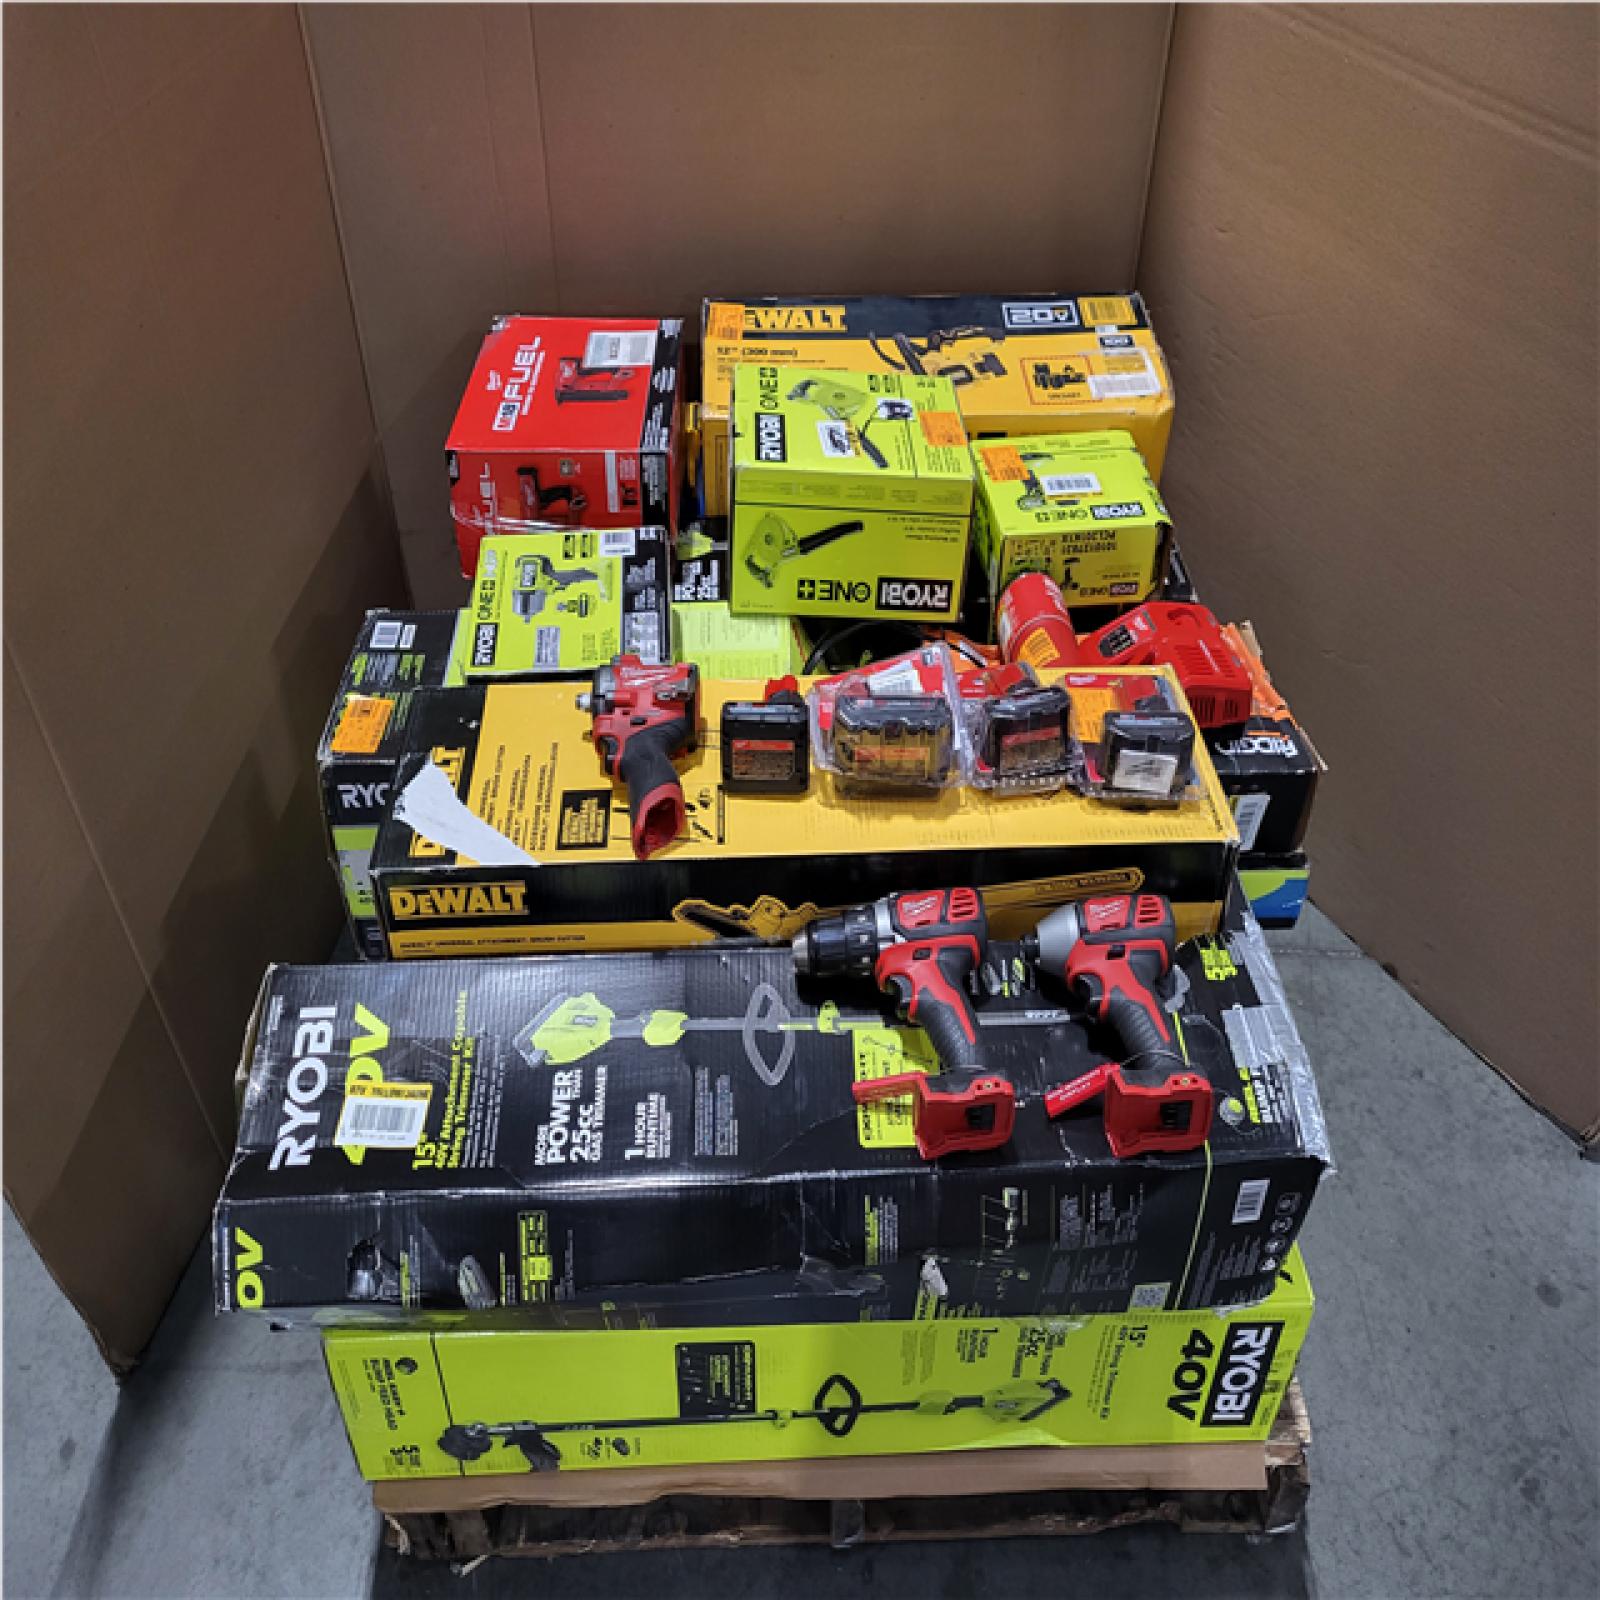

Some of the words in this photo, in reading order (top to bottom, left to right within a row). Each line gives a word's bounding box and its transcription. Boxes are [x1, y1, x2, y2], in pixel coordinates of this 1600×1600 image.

[744, 307, 848, 331] EWALT
[503, 335, 541, 401] FUEL
[759, 415, 781, 461] RYOBI
[797, 579, 871, 604] ONE+
[881, 582, 949, 609] RYOBI
[475, 624, 496, 666] RYOBI
[390, 885, 530, 916] DEWALT
[267, 1006, 338, 1171] RYOBI
[440, 1055, 461, 1141] Attachment
[454, 1061, 472, 1124] Trimmer
[547, 1070, 572, 1164] POWER
[594, 1065, 609, 1128] TRIMMER
[570, 1104, 595, 1164] 25cc
[634, 1102, 649, 1146] HOUR
[624, 1148, 645, 1161] 1
[1167, 1329, 1216, 1422] 40V
[1211, 1326, 1274, 1421] RYOBI
